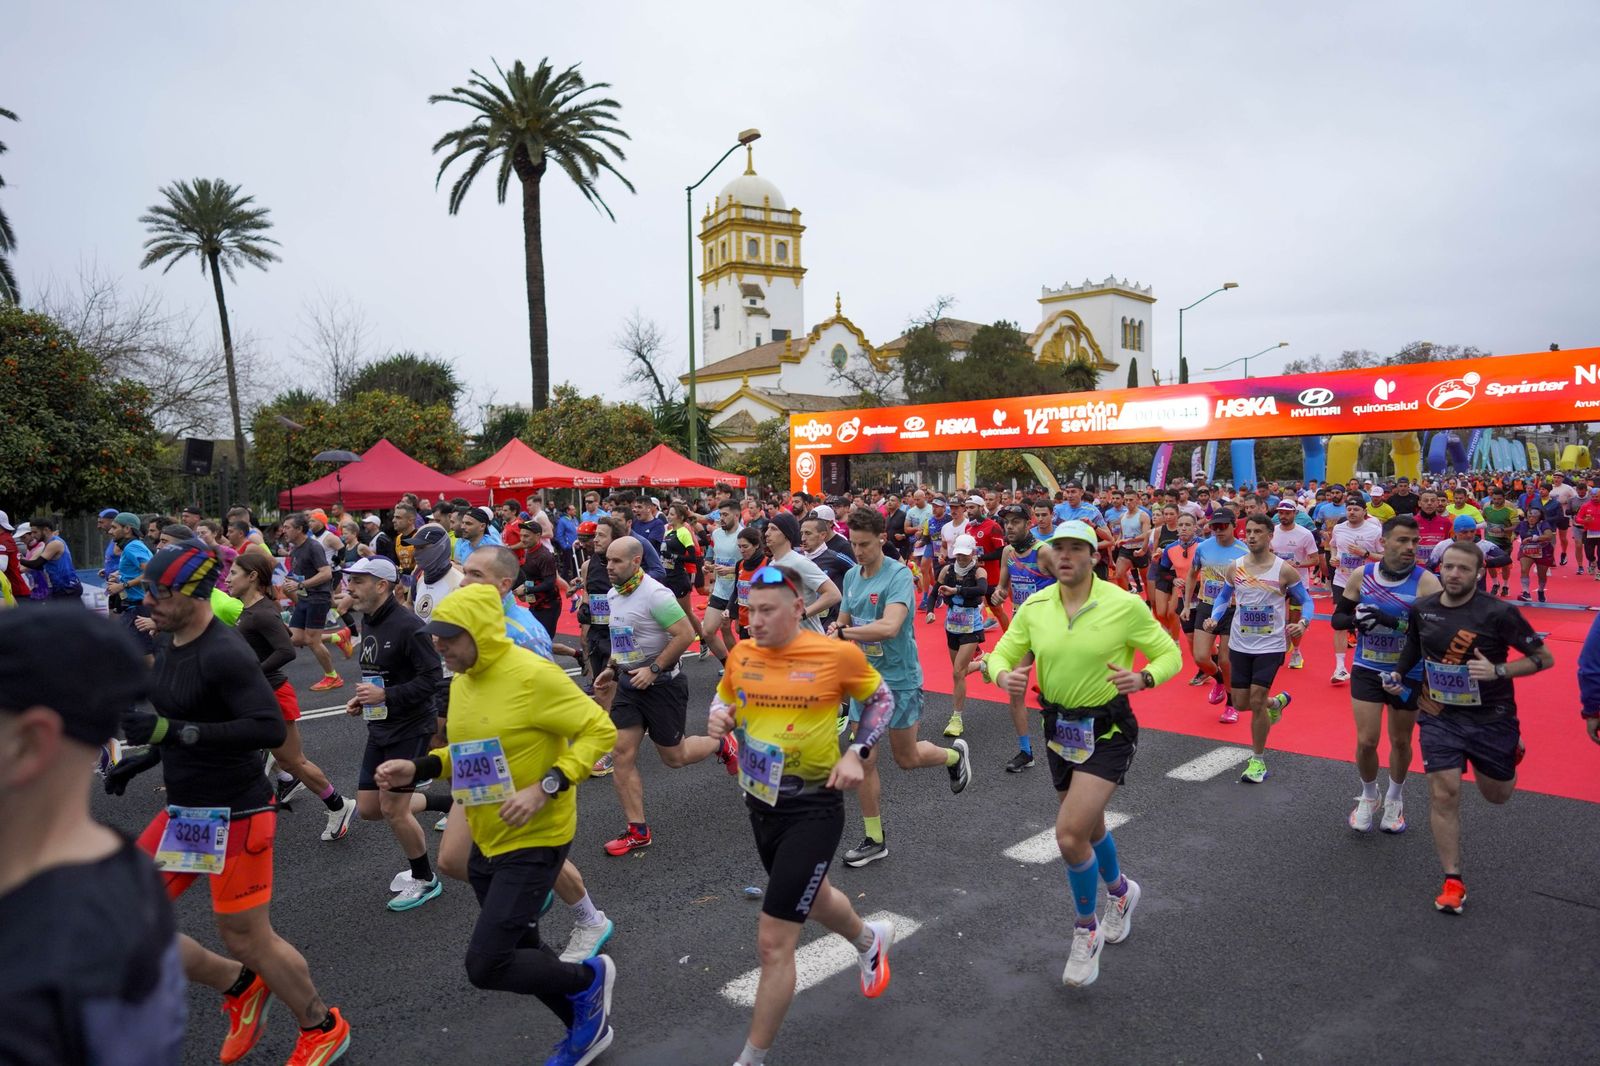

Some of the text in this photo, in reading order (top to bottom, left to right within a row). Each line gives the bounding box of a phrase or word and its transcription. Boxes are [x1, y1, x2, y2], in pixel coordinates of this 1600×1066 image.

[1573, 364, 1600, 386] N
[1485, 380, 1569, 397] Sprinter
[1041, 401, 1118, 421] maratón
[1214, 396, 1279, 418] HOKA
[1290, 406, 1341, 418] HYUNDAI
[862, 425, 898, 437] Sprinter
[934, 417, 977, 436] HOKA
[1061, 415, 1119, 433] sevilla
[899, 430, 929, 439] HYUNDAI
[592, 601, 610, 611] 3465
[1243, 612, 1267, 622] 3098
[1441, 629, 1478, 665] NCIA
[1432, 672, 1464, 688] 3326
[747, 693, 778, 701] ESCUELA
[457, 756, 491, 778] 3249
[175, 822, 211, 844] 3284
